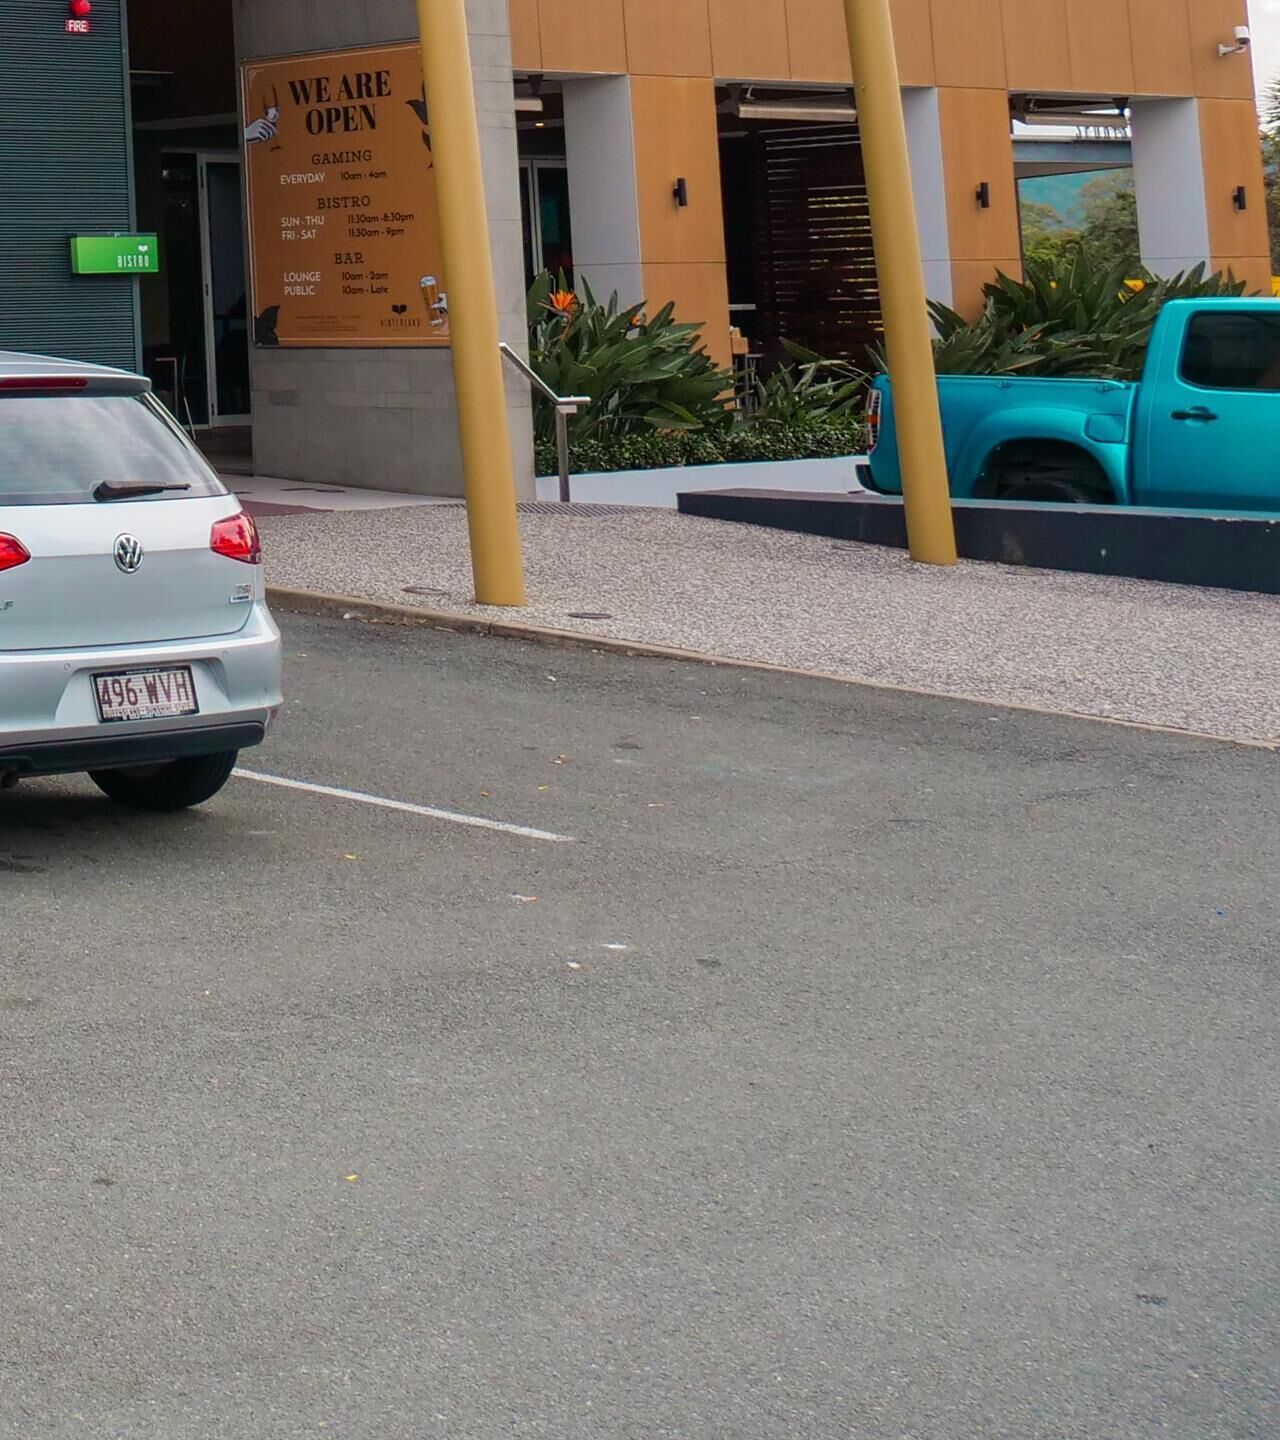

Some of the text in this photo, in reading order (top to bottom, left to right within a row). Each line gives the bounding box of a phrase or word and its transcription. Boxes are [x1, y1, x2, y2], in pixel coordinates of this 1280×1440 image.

[68, 20, 88, 32] FIRE
[288, 70, 391, 106] WE ARE
[306, 104, 376, 135] OPEN
[311, 150, 372, 165] GAMING
[280, 172, 325, 185] EVERYDAY
[317, 195, 371, 209] BISTRO
[281, 217, 300, 227] SUN
[306, 216, 324, 225] THU
[282, 231, 295, 240] FRI
[301, 229, 316, 239] SAT
[117, 255, 149, 267] BISTRO
[334, 252, 364, 264] BAR
[284, 272, 321, 282] LOUNGE
[284, 285, 315, 295] PUBLIC
